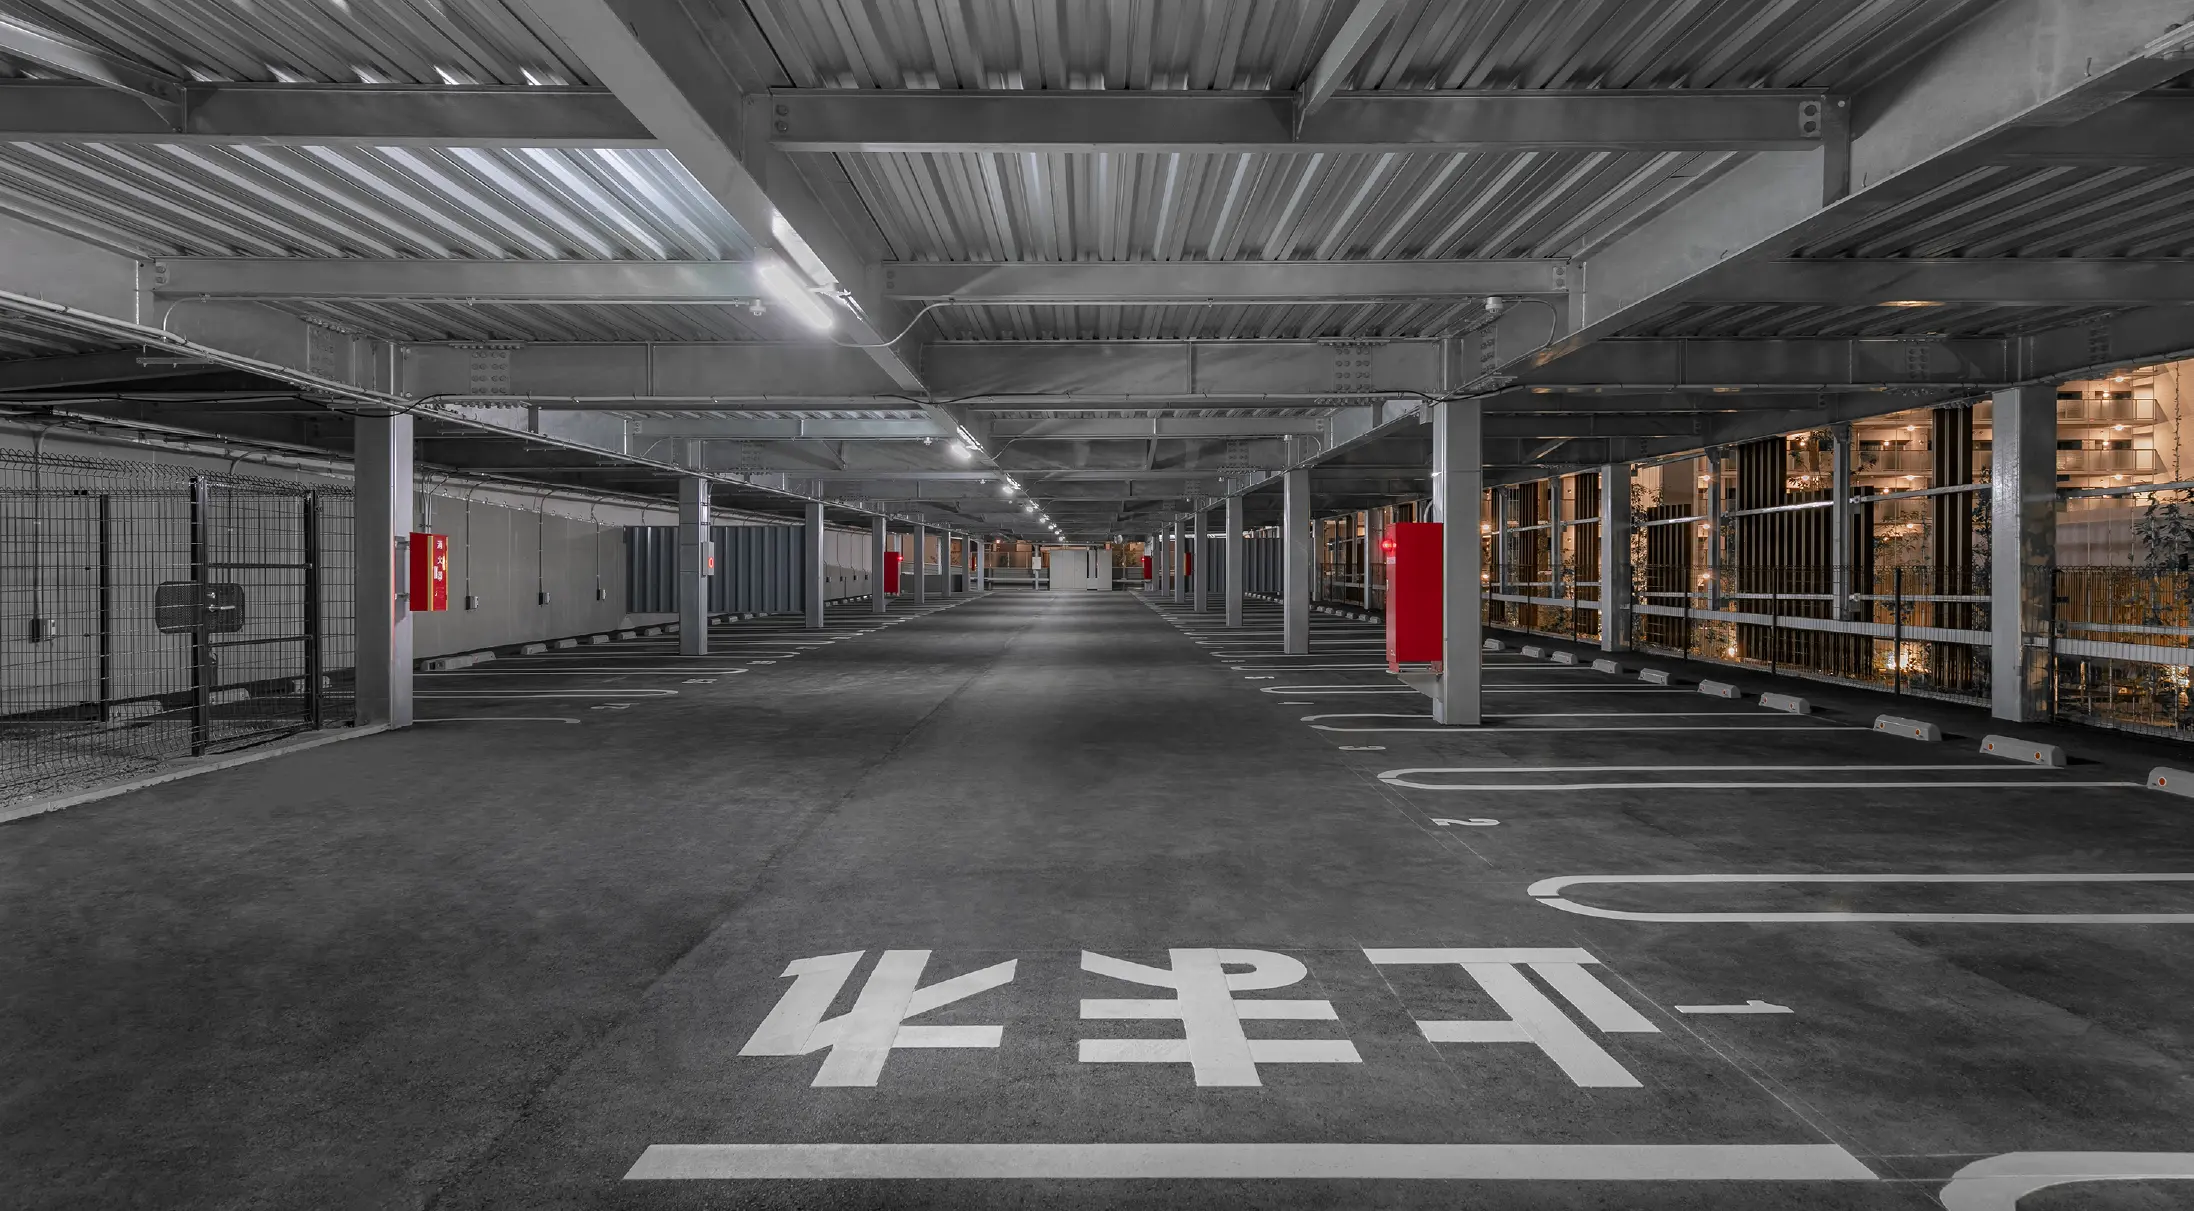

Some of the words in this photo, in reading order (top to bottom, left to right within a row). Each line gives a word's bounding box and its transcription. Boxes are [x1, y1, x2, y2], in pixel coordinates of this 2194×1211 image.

[1431, 818, 1501, 826] 2
[1674, 999, 1795, 1014] 1
[738, 948, 1661, 1087] 止まれ
